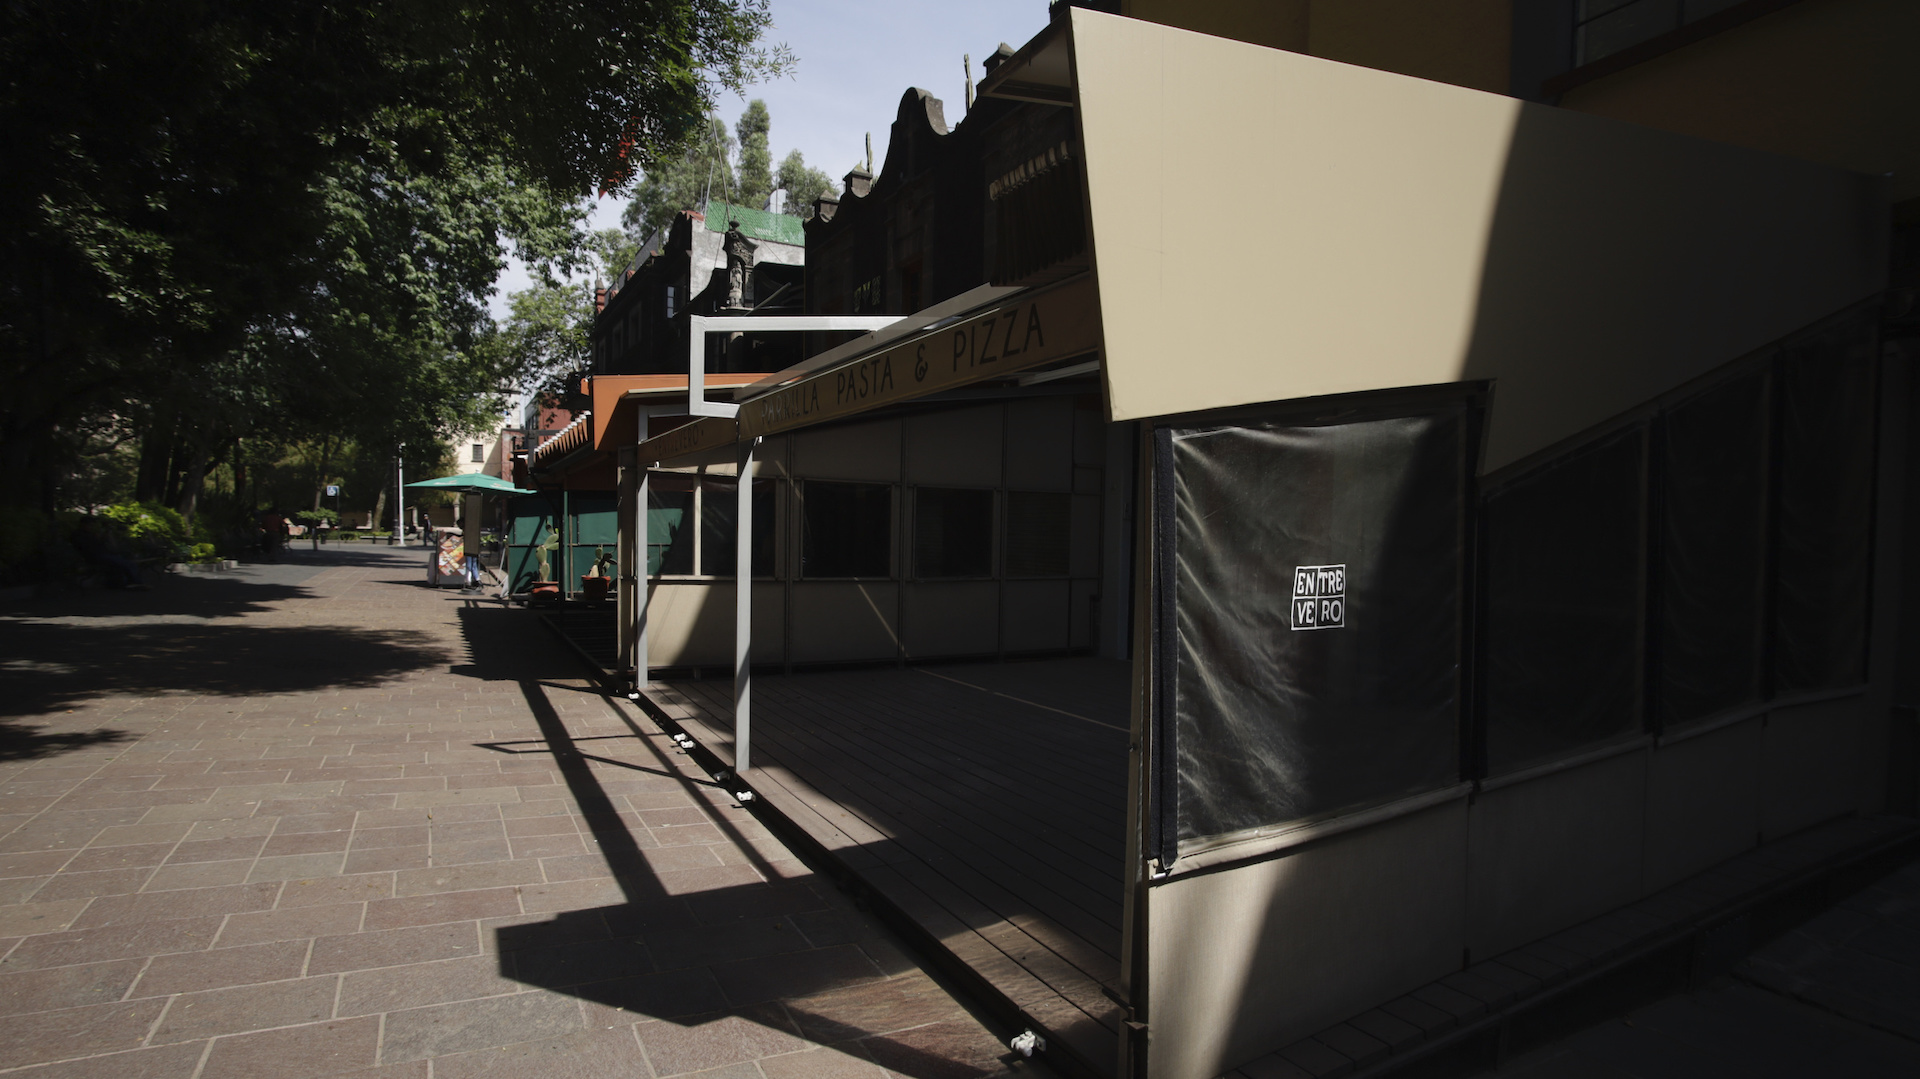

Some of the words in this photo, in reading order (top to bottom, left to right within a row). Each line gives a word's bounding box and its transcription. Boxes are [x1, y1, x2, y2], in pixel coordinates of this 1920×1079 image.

[761, 382, 819, 425] PARRILLA
[837, 356, 893, 405] PASTA
[914, 343, 929, 383] &
[953, 303, 1044, 373] PIZZA
